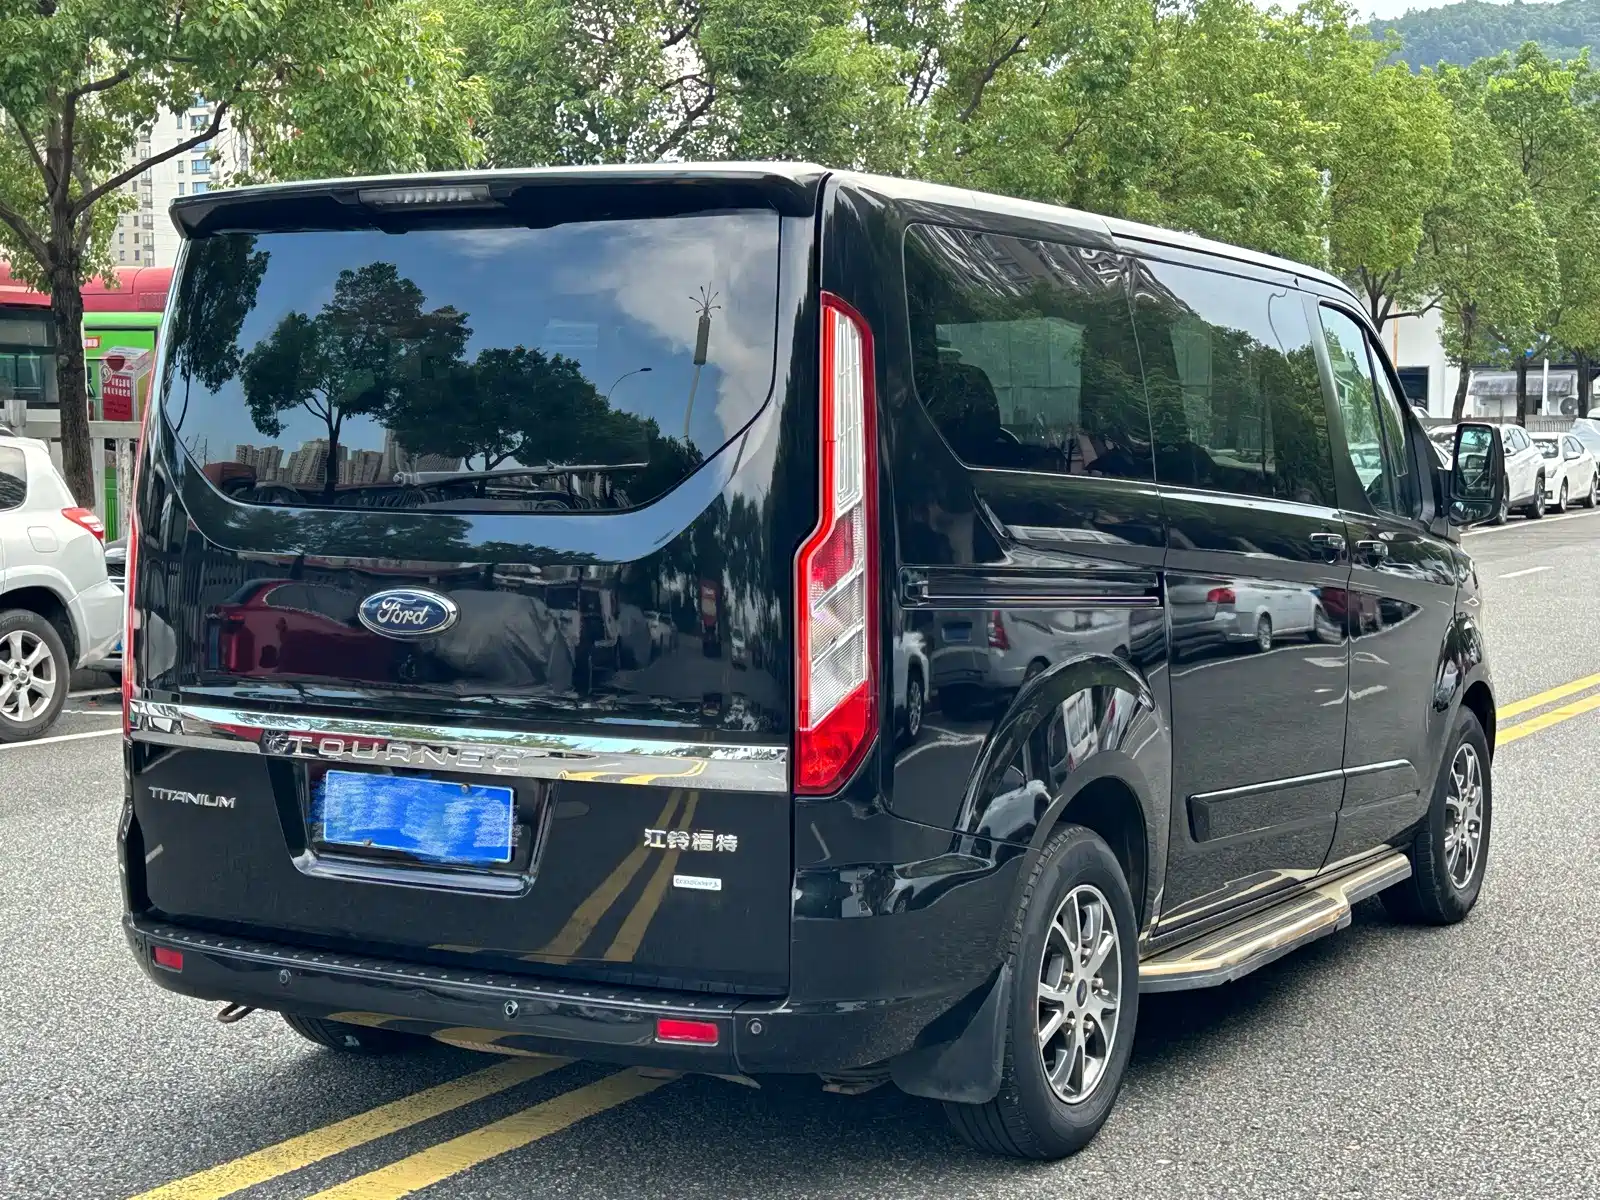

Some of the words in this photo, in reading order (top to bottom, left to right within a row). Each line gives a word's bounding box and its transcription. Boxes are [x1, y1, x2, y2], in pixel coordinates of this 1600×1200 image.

[377, 597, 428, 625] Ford
[148, 786, 237, 809] TITANIUM
[643, 827, 738, 853] 江铃福特
